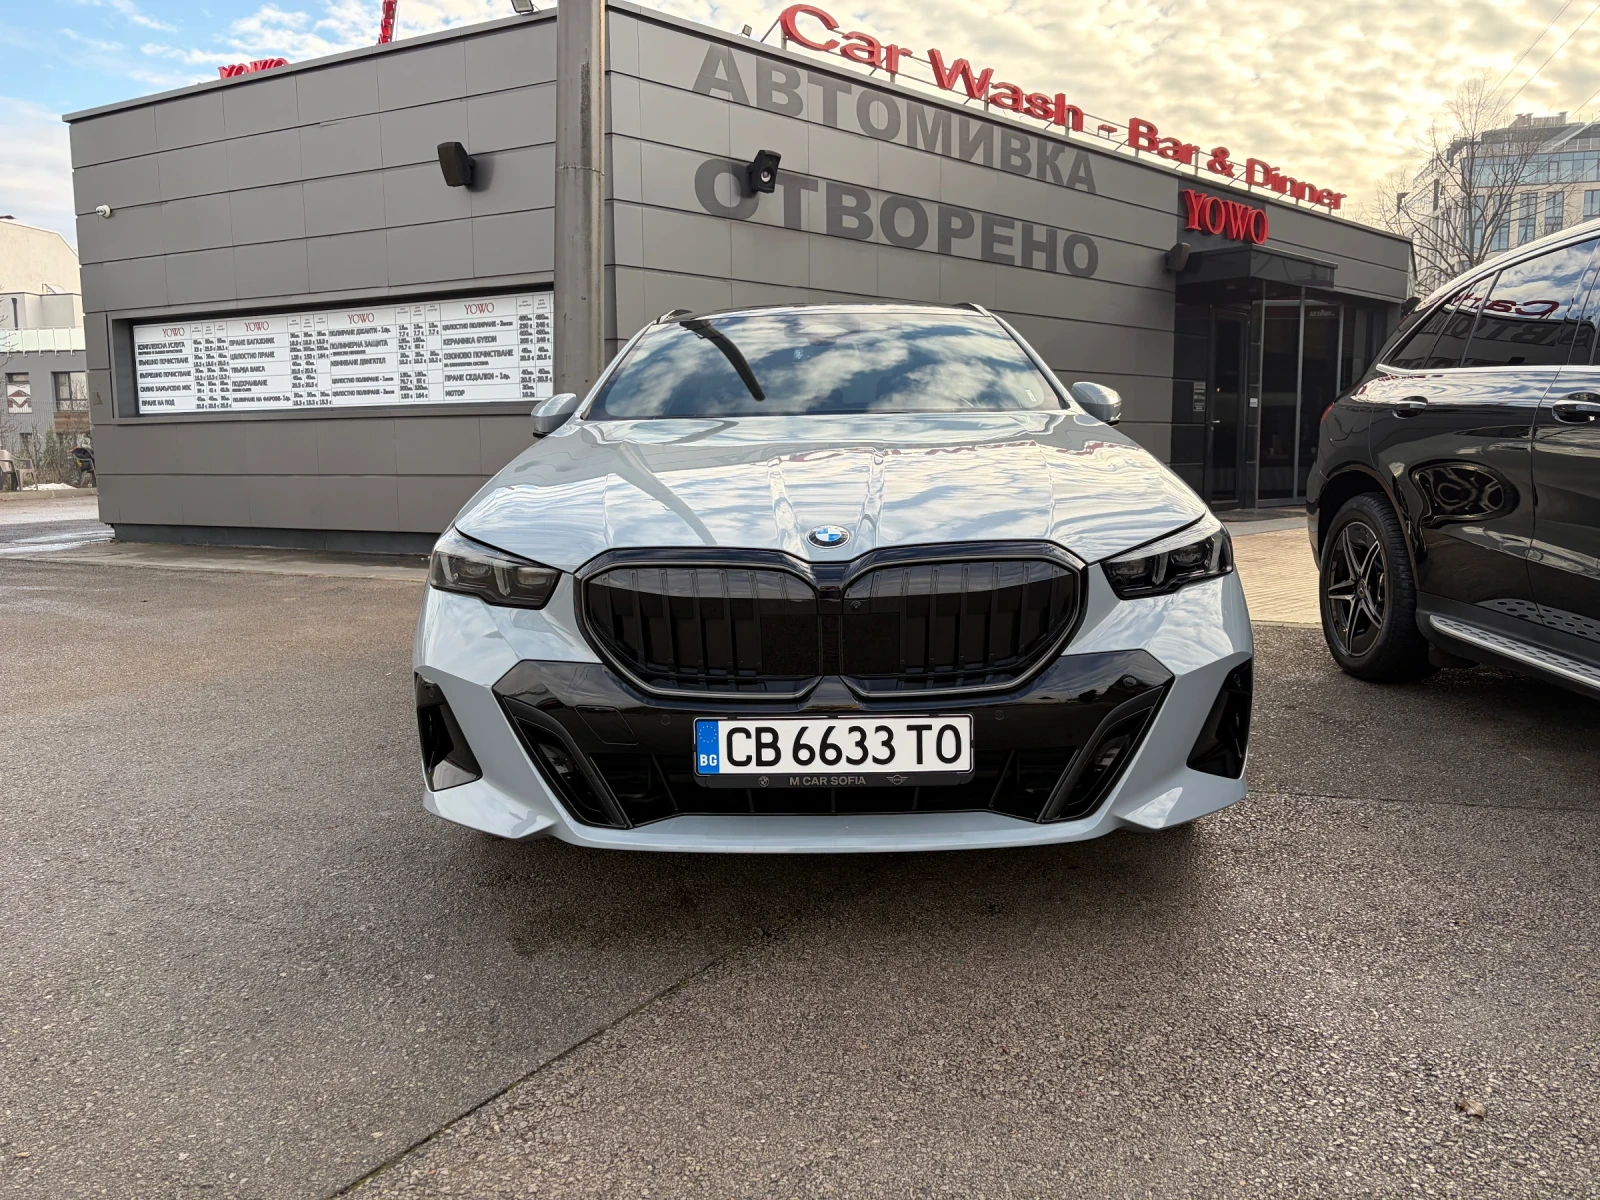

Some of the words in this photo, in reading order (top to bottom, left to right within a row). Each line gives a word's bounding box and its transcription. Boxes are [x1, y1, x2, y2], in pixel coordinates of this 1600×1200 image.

[780, 4, 912, 73] Car
[927, 48, 1083, 132] Wash
[1128, 117, 1200, 164] Bar
[1207, 147, 1235, 178] &
[1246, 158, 1347, 209] Dinner
[692, 43, 1097, 194] АВТОМИВКА
[694, 158, 1099, 278] ОТВОРЕНО
[1183, 189, 1268, 245] YOWO
[464, 302, 494, 314] YOWO
[348, 313, 374, 324] YOWO
[162, 327, 185, 337] YOWO
[245, 321, 269, 331] YOWO
[473, 349, 513, 358] ПОЧИСТВАНЕ
[700, 754, 718, 767] BG
[726, 726, 782, 768] CB
[792, 725, 896, 766] 6633
[906, 724, 962, 766] TO
[789, 776, 801, 787] M
[802, 776, 828, 787] CAR
[830, 775, 867, 787] SOFIA
